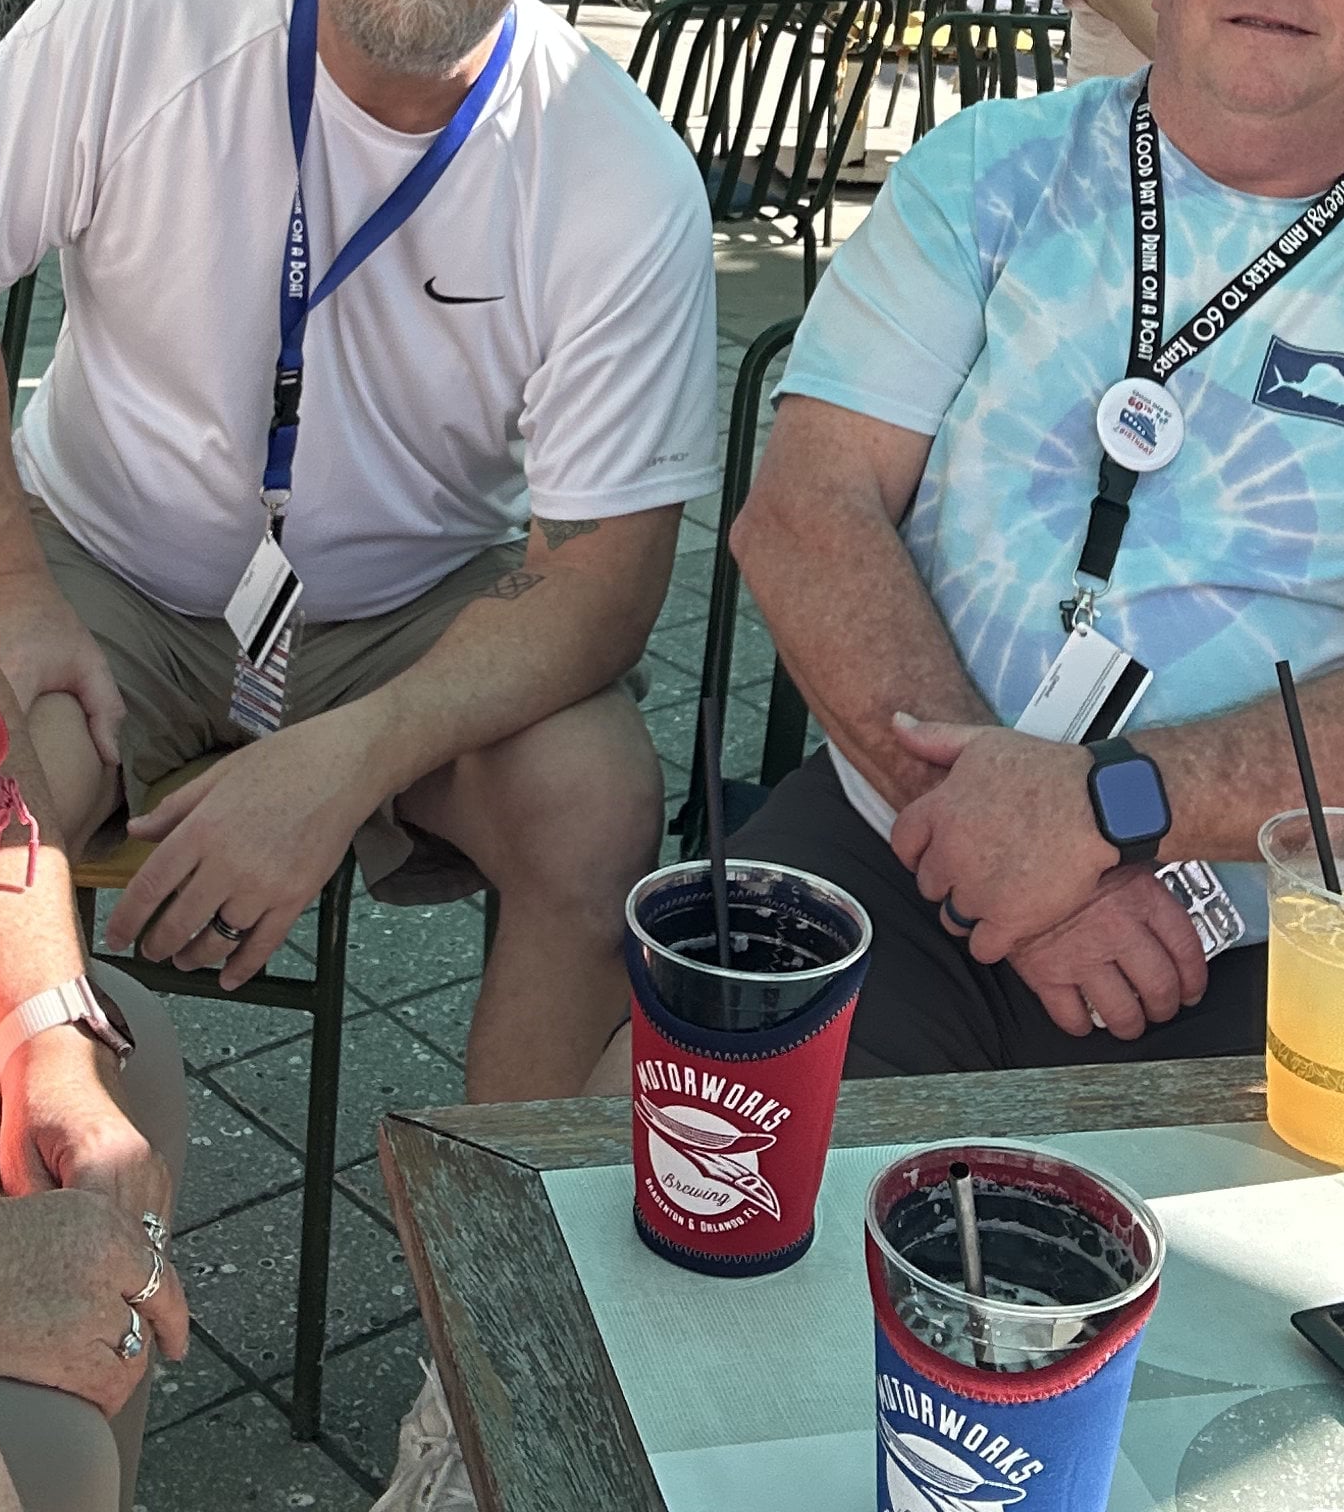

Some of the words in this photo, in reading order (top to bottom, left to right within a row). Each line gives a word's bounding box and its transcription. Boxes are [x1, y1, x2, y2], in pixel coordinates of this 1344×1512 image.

[1136, 133, 1154, 178] GOOD
[1139, 180, 1158, 208] DAY
[291, 218, 304, 243] ON
[1140, 209, 1158, 230] TO
[1141, 234, 1161, 273] DRINK
[1278, 223, 1310, 256] AND
[288, 260, 308, 300] BOAT
[1242, 249, 1287, 292] BEERS
[1141, 277, 1158, 301] ON
[1221, 284, 1250, 311] TO
[1141, 305, 1158, 315] A
[1192, 306, 1225, 342] 60
[1137, 317, 1160, 362] BOAT
[1152, 336, 1199, 377] YEARS
[635, 1059, 793, 1133] MOTORWORKS
[660, 1172, 732, 1208] Brewing
[877, 1373, 1046, 1485] MOTORWORKS
